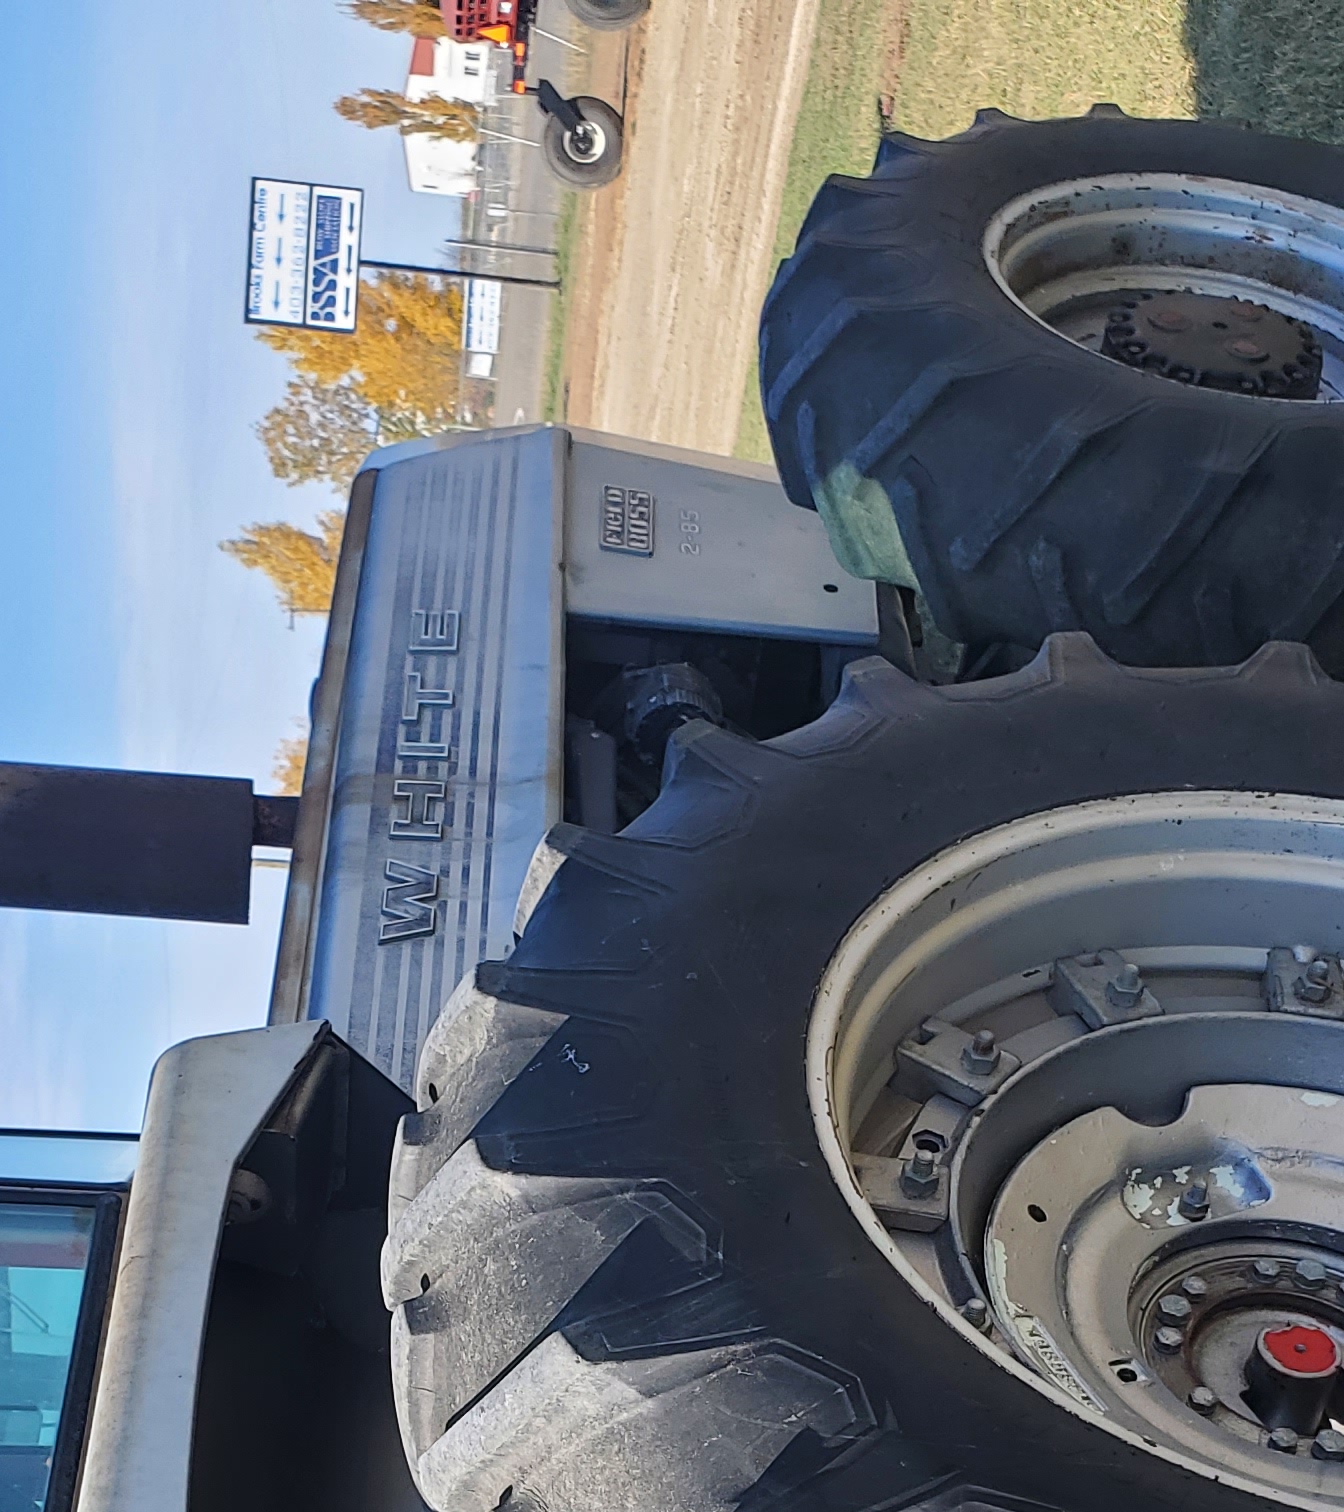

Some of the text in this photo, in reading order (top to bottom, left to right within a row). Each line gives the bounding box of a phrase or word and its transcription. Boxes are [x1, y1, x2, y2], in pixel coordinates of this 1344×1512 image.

[310, 252, 340, 323] BSSA
[604, 489, 625, 545] FIELD
[627, 491, 650, 549] BOSS
[679, 510, 700, 556] 2-85
[376, 608, 461, 946] WHITE
